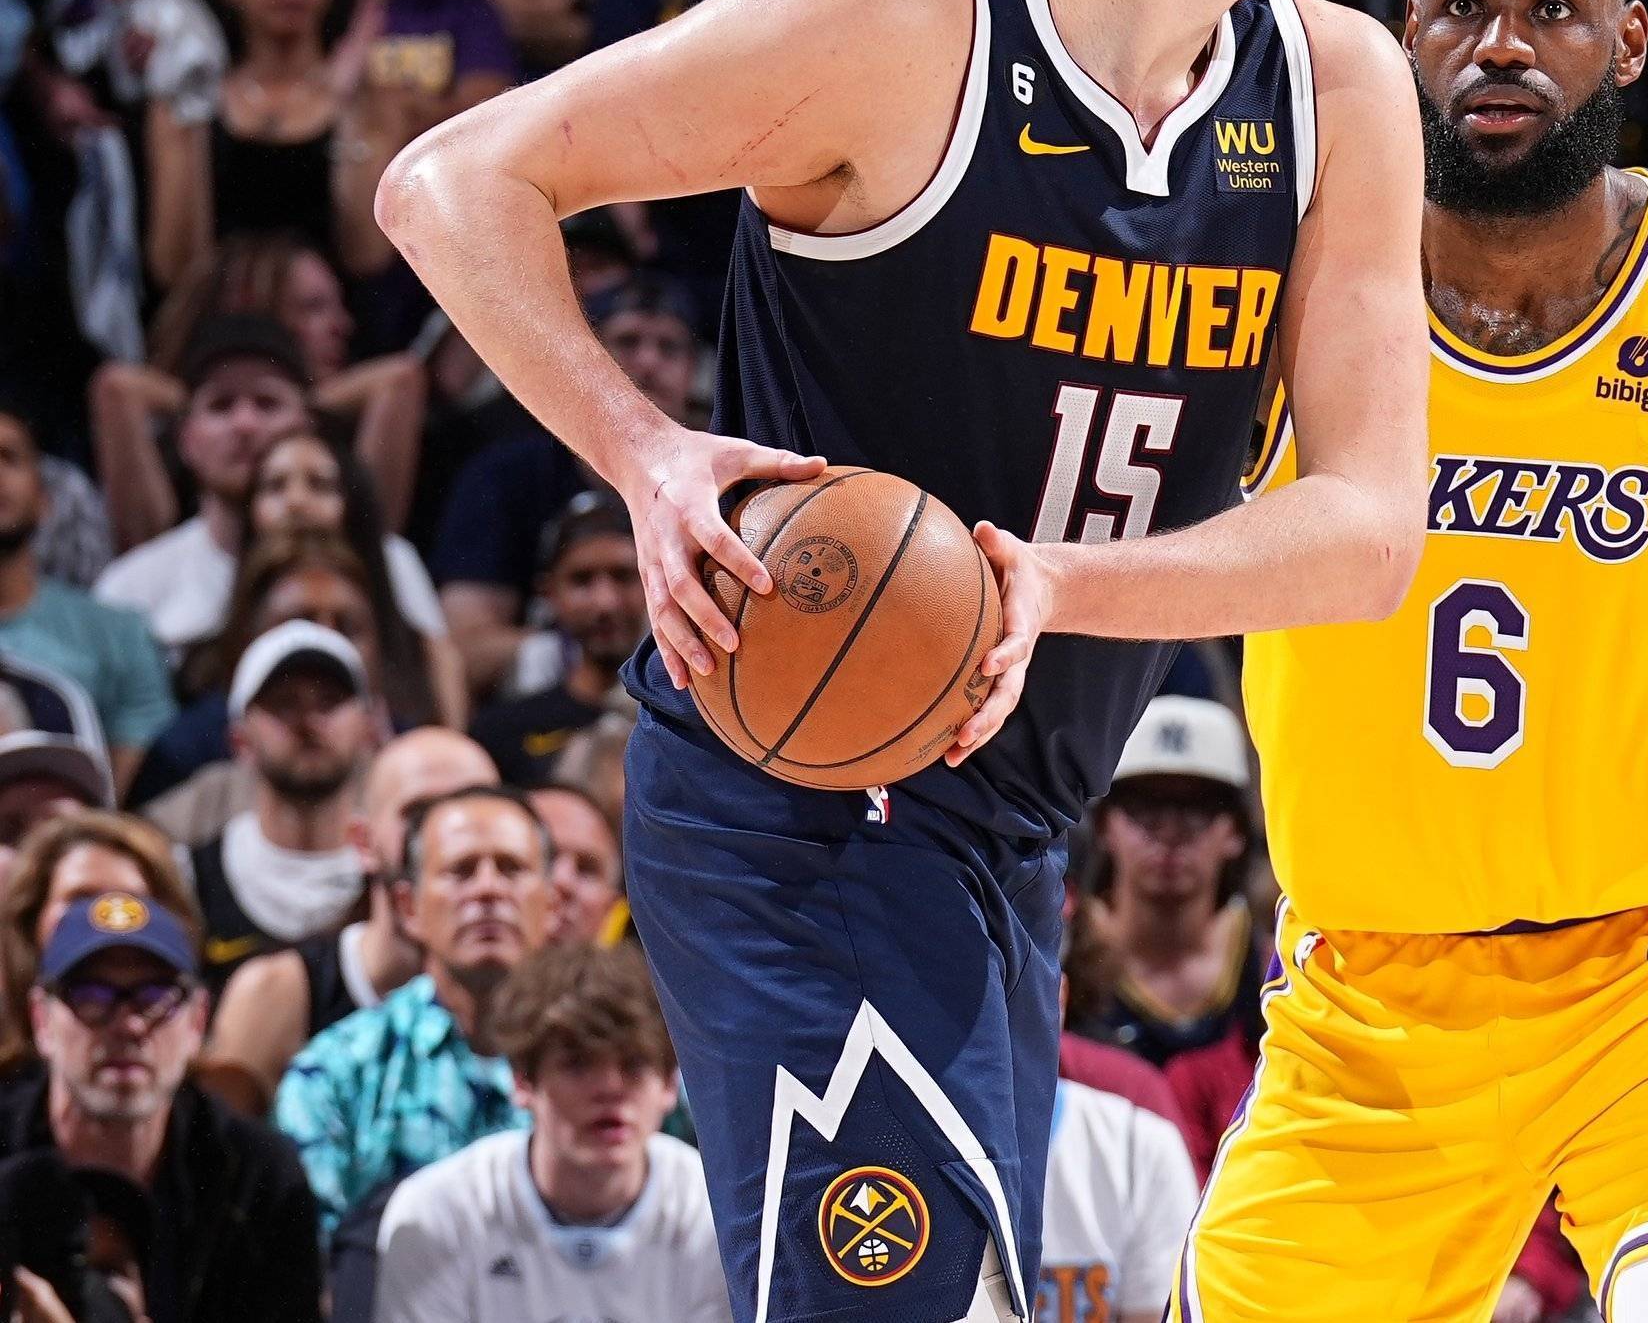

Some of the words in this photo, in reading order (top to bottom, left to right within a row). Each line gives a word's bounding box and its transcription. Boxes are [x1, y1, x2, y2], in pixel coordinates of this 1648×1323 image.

[1012, 62, 1036, 105] 6
[1215, 121, 1275, 155] WU
[1217, 158, 1280, 173] Western
[1229, 173, 1272, 189] Union
[968, 230, 1282, 371] DENVER
[1030, 380, 1187, 545] 15
[1422, 577, 1531, 770] 6
